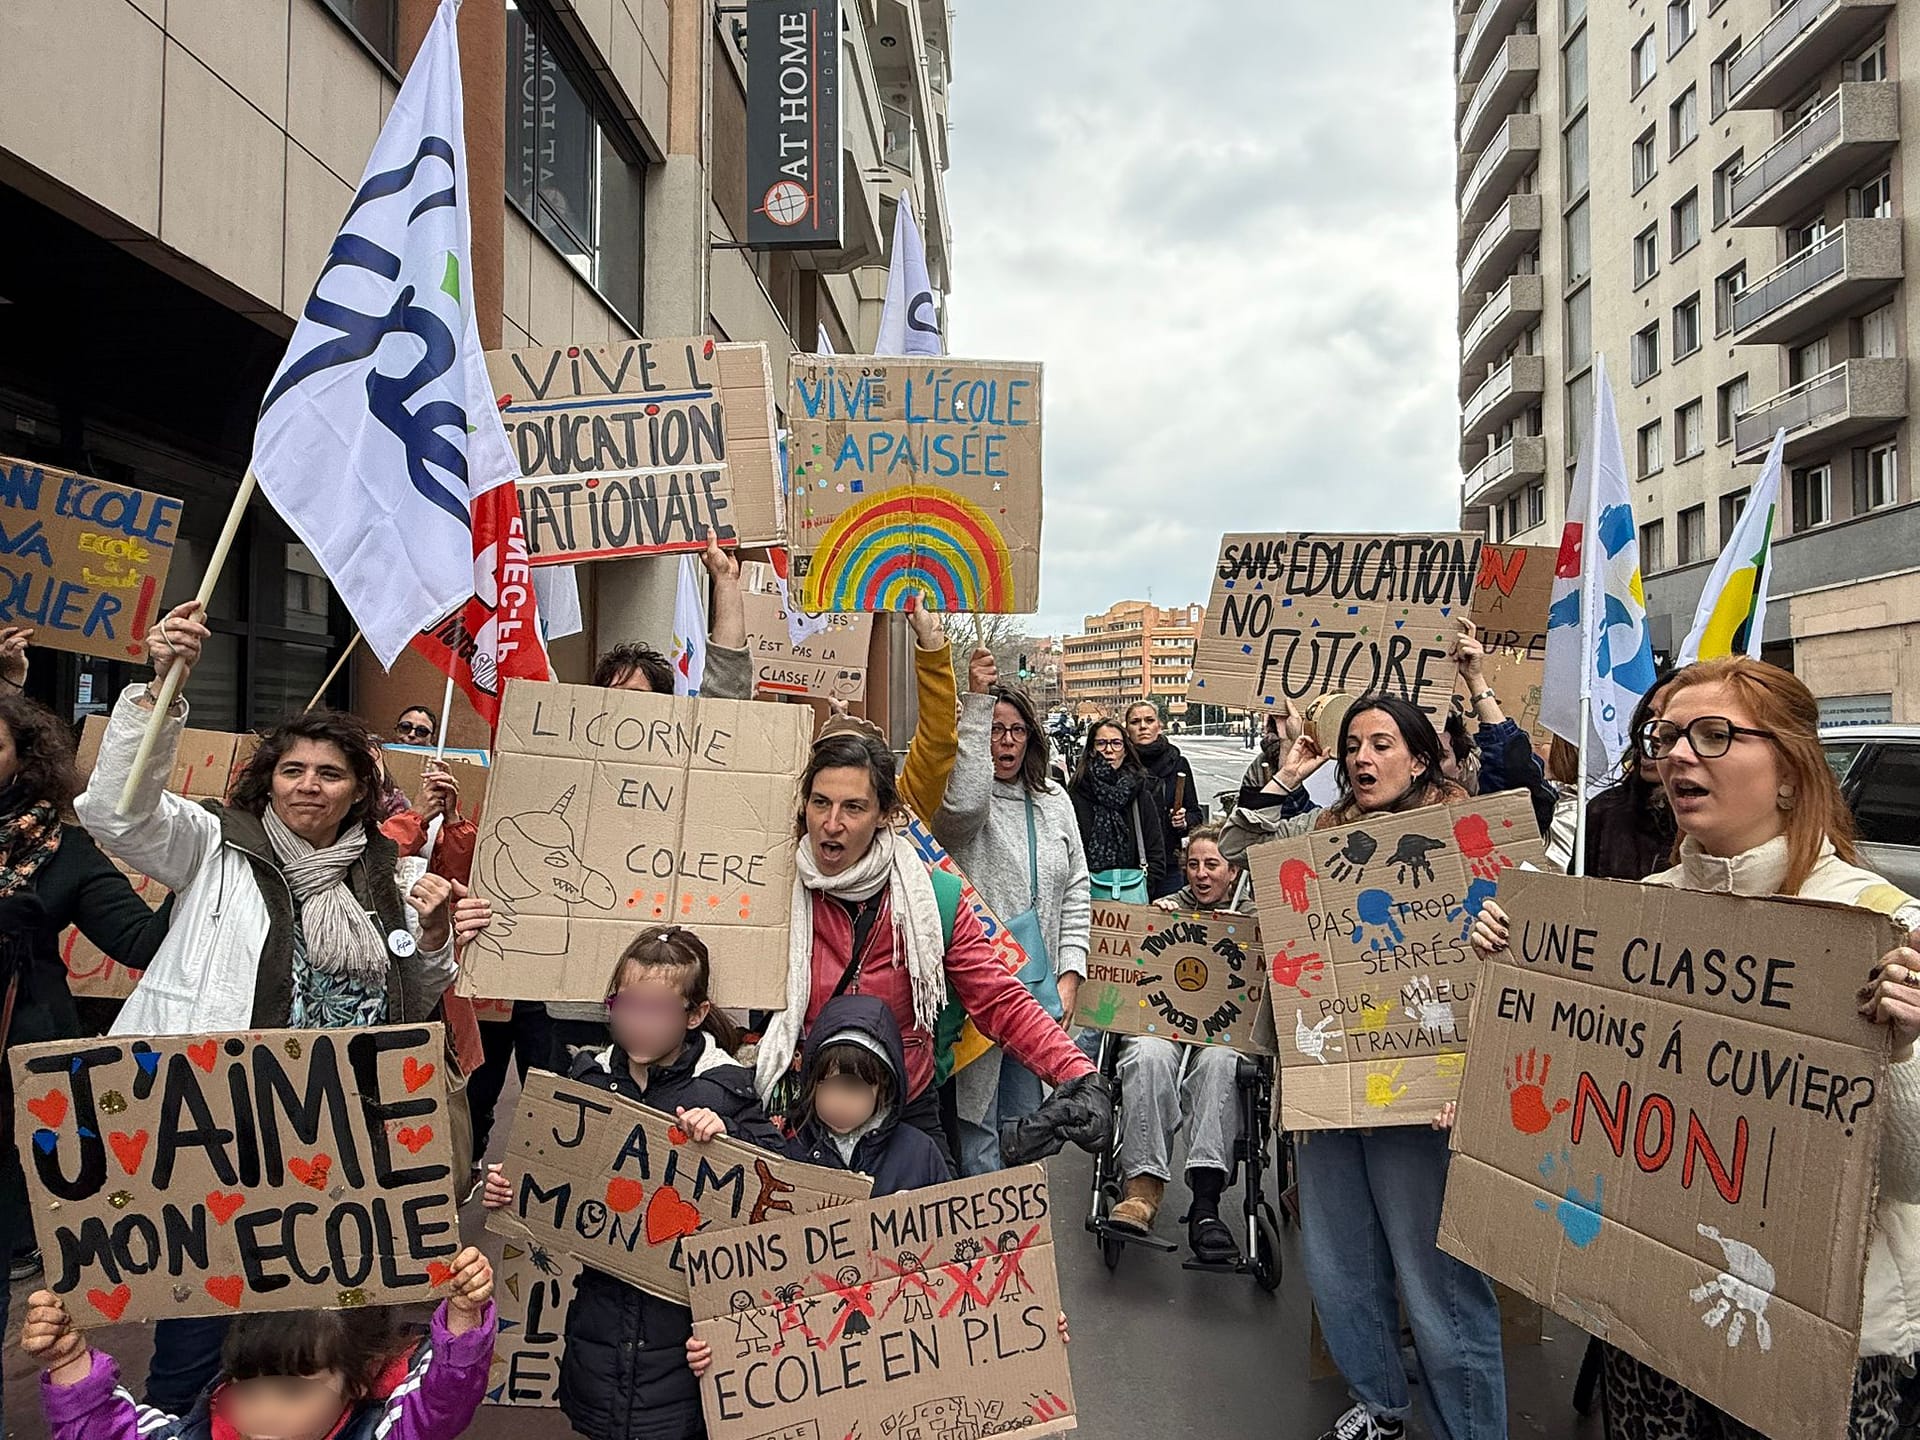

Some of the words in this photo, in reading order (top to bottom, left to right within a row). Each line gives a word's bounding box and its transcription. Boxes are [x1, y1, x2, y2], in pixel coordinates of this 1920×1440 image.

[779, 12, 807, 124] HOME
[780, 133, 807, 181] AT
[685, 340, 713, 390] L'
[905, 369, 1031, 426] L'ÉCOLE
[833, 425, 1010, 477] APAISÉE
[1218, 540, 1287, 581] SANS
[1220, 594, 1274, 638] NO
[791, 645, 812, 658] PAS
[822, 649, 836, 660] LA
[1256, 629, 1447, 714] FUTURE
[758, 666, 809, 686] CLASSE
[532, 701, 732, 767] LICORNE
[617, 778, 674, 812] EN
[626, 844, 767, 887] COLERE
[1092, 909, 1130, 931] NON
[1140, 921, 1208, 957] TOUCHE
[1307, 908, 1356, 942] PAS
[1391, 893, 1456, 925] TROP
[1212, 938, 1246, 971] PAS
[1361, 932, 1466, 975] SERRÉS
[1522, 920, 1598, 971] UNE
[1622, 937, 1796, 1009] CLASSE
[1228, 973, 1246, 989] A
[1147, 990, 1198, 1035] ECOLE
[1202, 1000, 1242, 1037] MON
[1320, 993, 1376, 1018] POUR
[1498, 987, 1535, 1024] EN
[519, 1173, 643, 1252] MON
[686, 1231, 788, 1287] MOINS
[804, 1218, 856, 1265] DE
[871, 1182, 1048, 1252] MAITRESSES
[53, 1203, 209, 1294] MON
[234, 1193, 458, 1294] ECOLE
[714, 1340, 867, 1421] ECOLE
[880, 1323, 940, 1383] EN
